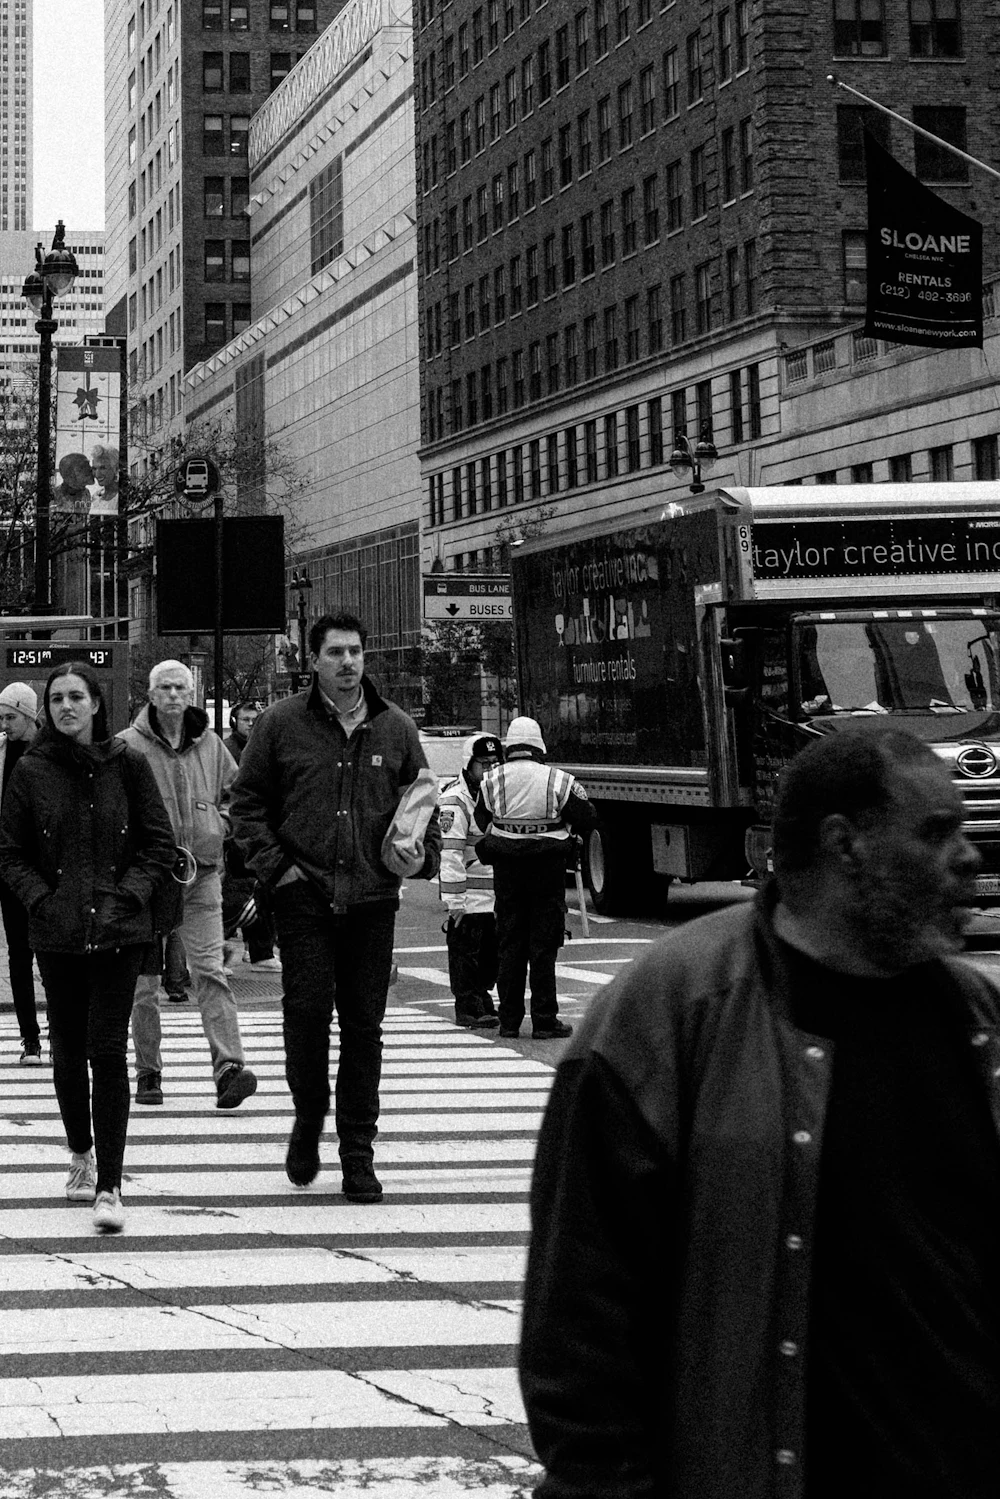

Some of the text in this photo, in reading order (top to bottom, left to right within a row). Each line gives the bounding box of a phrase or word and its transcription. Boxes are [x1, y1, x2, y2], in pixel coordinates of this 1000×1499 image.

[880, 227, 971, 253] SLOANE
[905, 253, 930, 261] CHELSEA
[898, 271, 952, 288] RENTALS
[880, 282, 911, 299] (212)
[874, 321, 977, 338] www.sloanenewyork.com
[754, 540, 835, 574] taylor
[844, 536, 955, 564] creative
[469, 584, 510, 593] BUS LANE
[552, 556, 580, 608] taylor
[582, 554, 624, 592] creative
[469, 604, 504, 615] BUSES
[573, 650, 637, 684] furniture rentals
[504, 824, 548, 834] NYPD
